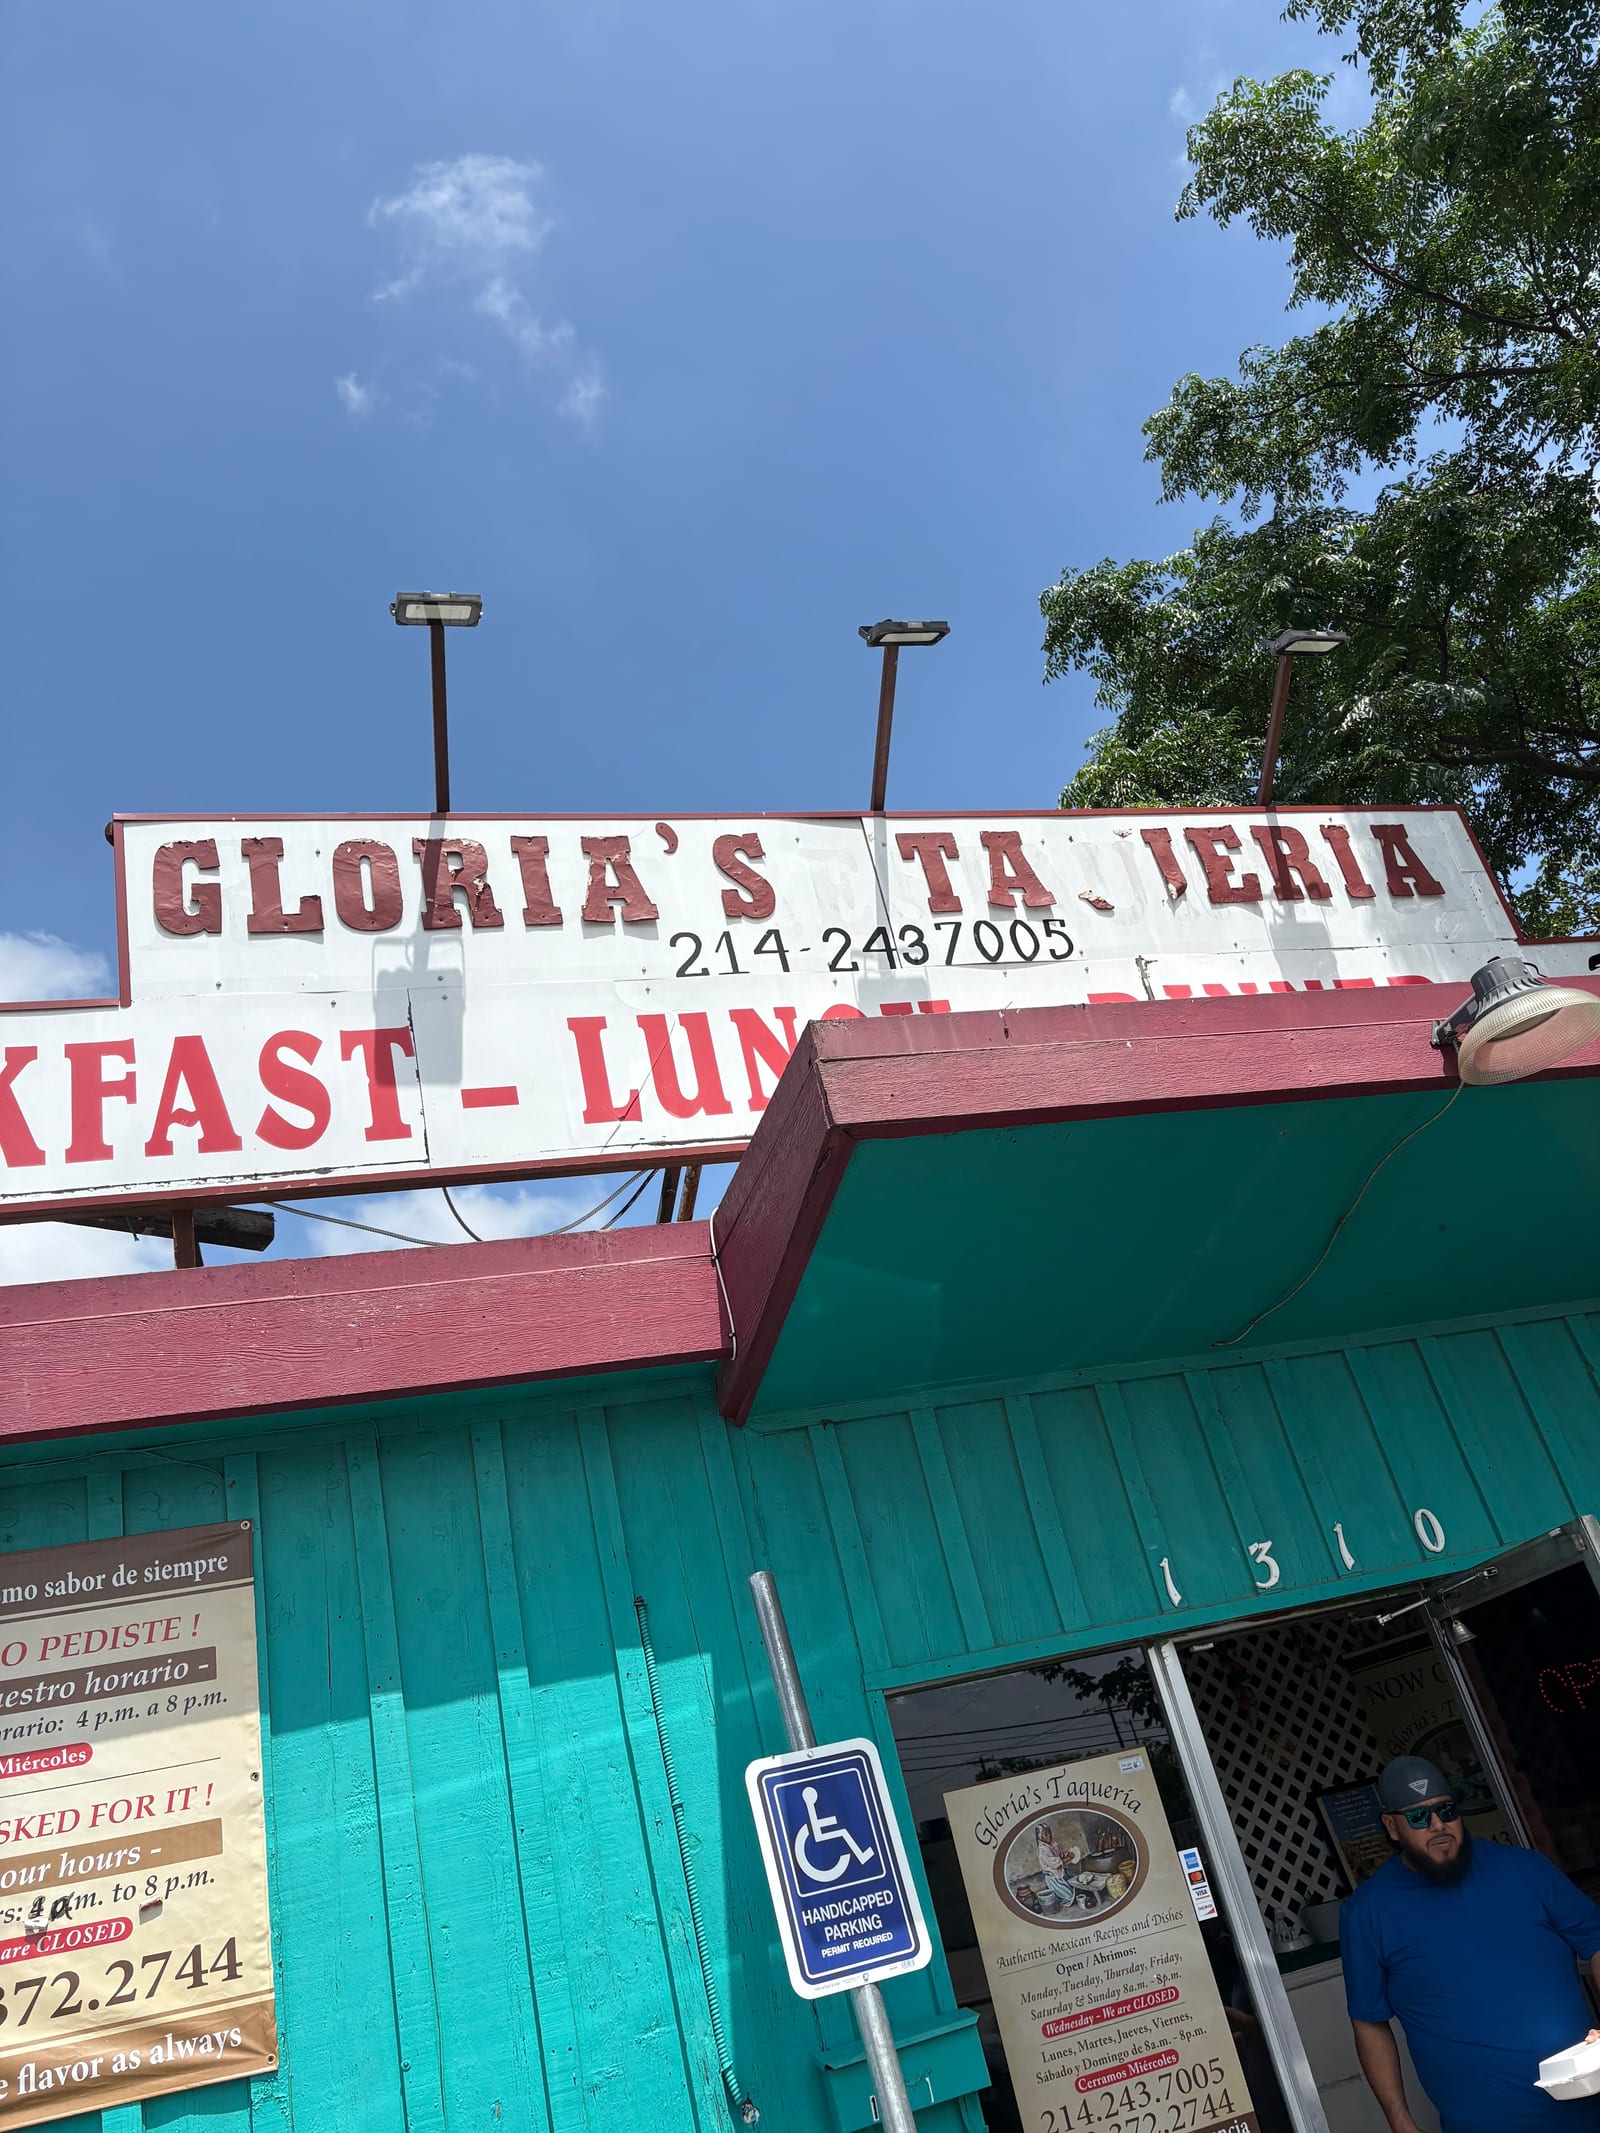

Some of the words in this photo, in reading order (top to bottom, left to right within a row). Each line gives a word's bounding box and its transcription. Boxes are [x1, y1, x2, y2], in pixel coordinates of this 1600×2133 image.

[153, 822, 776, 935] GLORIA'S
[0, 1584, 38, 1604] mo
[44, 1570, 106, 1599] sabor
[112, 1563, 138, 1586] de
[143, 1555, 229, 1583] siempre
[37, 1617, 182, 1661] PEDISTE
[0, 1680, 75, 1709] estro
[84, 1658, 190, 1696] horario
[1365, 1668, 1424, 1705] NOW
[1538, 1659, 1600, 1713] OP
[0, 1717, 64, 1742] rario:
[76, 1710, 89, 1728] 4
[94, 1708, 140, 1732] p.m.
[147, 1701, 160, 1717] a
[166, 1695, 179, 1713] 8
[183, 1691, 228, 1716] p.m.
[89, 1795, 155, 1828] FOR
[164, 1786, 198, 1813] IT
[974, 1786, 1042, 1850] Gloria's
[0, 1863, 51, 1889] our
[58, 1846, 141, 1880] hours
[113, 1883, 137, 1903] to
[144, 1875, 158, 1896] 8
[164, 1868, 215, 1900] p.m.
[801, 1889, 893, 1926] HANDICAPPED
[824, 1914, 883, 1942] PARKING
[0, 1944, 31, 1960] are
[36, 1921, 126, 1953] CLOSED
[821, 1942, 851, 1959] PERMIT
[852, 1931, 894, 1951] REQUIRED
[997, 1949, 1046, 1969] Authentic
[1048, 1936, 1092, 1957] Mexican
[1093, 1924, 1130, 1944] Recipes
[1131, 1914, 1150, 1932] and
[1151, 1907, 1184, 1927] Dishes
[1020, 1985, 1062, 2005] Monday,
[1062, 1974, 1104, 1992] Tuesday,
[1104, 1961, 1148, 1981] Thursday,
[1149, 1952, 1183, 1971] Friday,
[1056, 1961, 1084, 1978] Open
[1092, 1947, 1137, 1966] Abrimos:
[1031, 2001, 1074, 2020] Saturday
[1075, 1995, 1085, 2007] &
[1087, 1986, 1121, 2005] Sunday
[1045, 2015, 1094, 2036] Wednesday
[1102, 2007, 1116, 2019] We
[1117, 2005, 1131, 2015] are
[1133, 1989, 1176, 2010] CLOSED
[1041, 2047, 1077, 2064] Lunes,
[1078, 2036, 1117, 2054] Martes,
[1117, 2025, 1152, 2044] Jueves,
[1152, 2012, 1193, 2030] Viernes,
[17, 2056, 104, 2096] flavor
[112, 2048, 142, 2074] as
[149, 2027, 242, 2064] always
[1036, 2068, 1073, 2085] Sábado
[1075, 2066, 1081, 2076] y
[1083, 2050, 1129, 2069] Domingo
[1132, 2045, 1143, 2057] de
[1078, 2071, 1127, 2091] Cerramos
[1128, 2053, 1177, 2075] Miércoles
[1040, 2057, 1225, 2133] 214.243.7005
